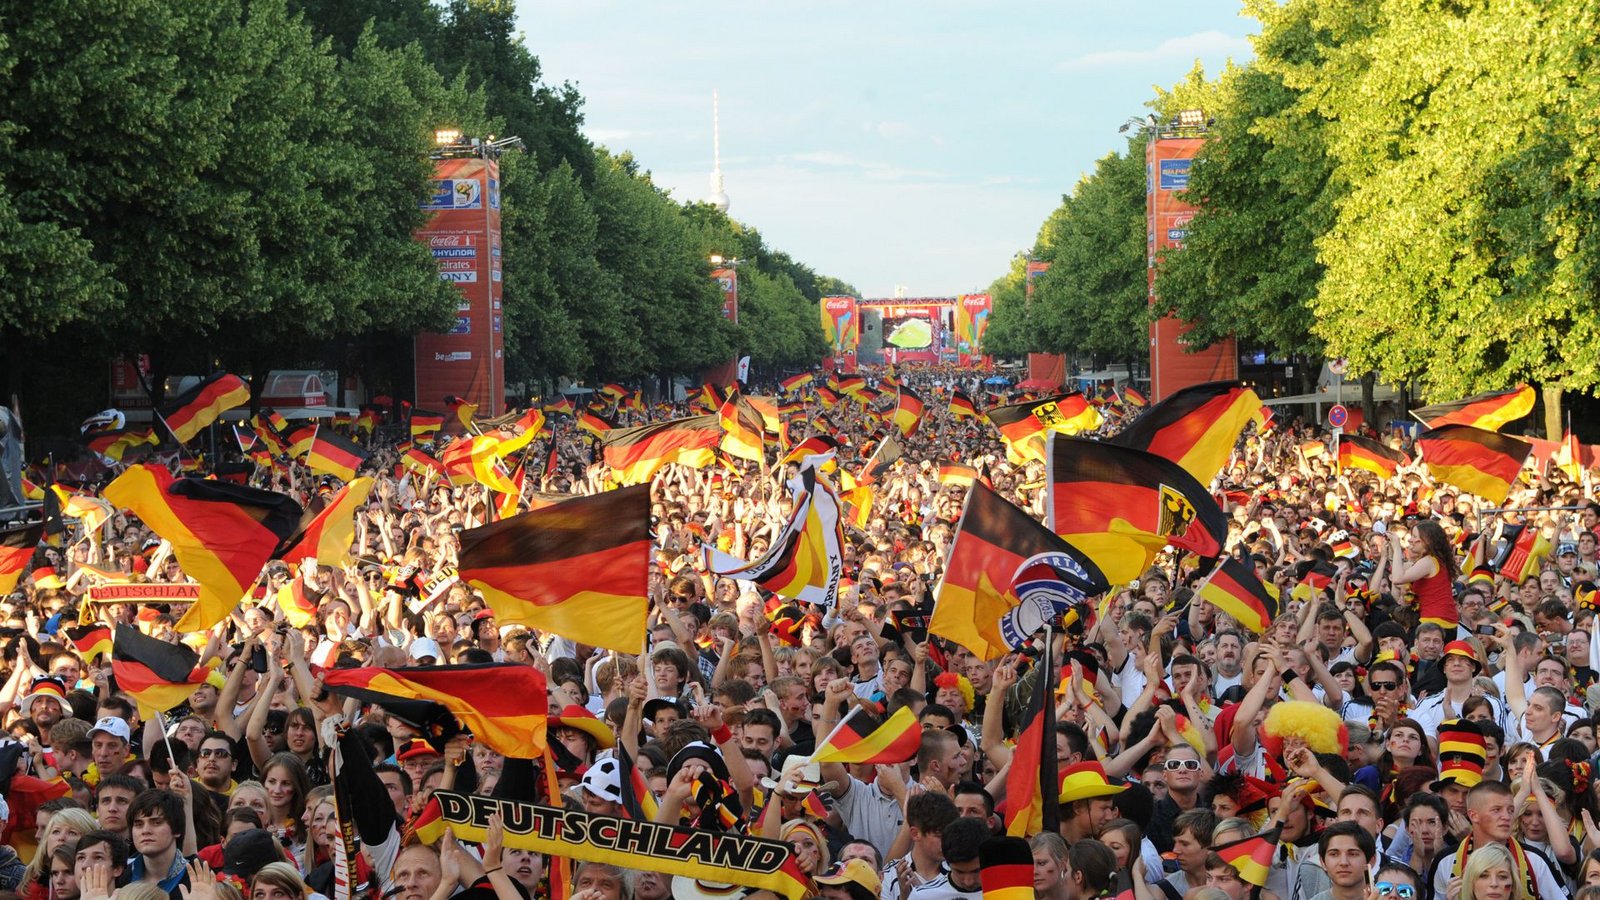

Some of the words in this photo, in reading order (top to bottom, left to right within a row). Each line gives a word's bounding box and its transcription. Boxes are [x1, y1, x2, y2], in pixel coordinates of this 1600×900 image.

[437, 249, 475, 257] HYUNDAI
[440, 273, 473, 281] ONY
[824, 555, 838, 606] ERMANY
[90, 585, 199, 599] DEUTSCHLAN
[434, 791, 791, 874] DEUTSCHLAND
